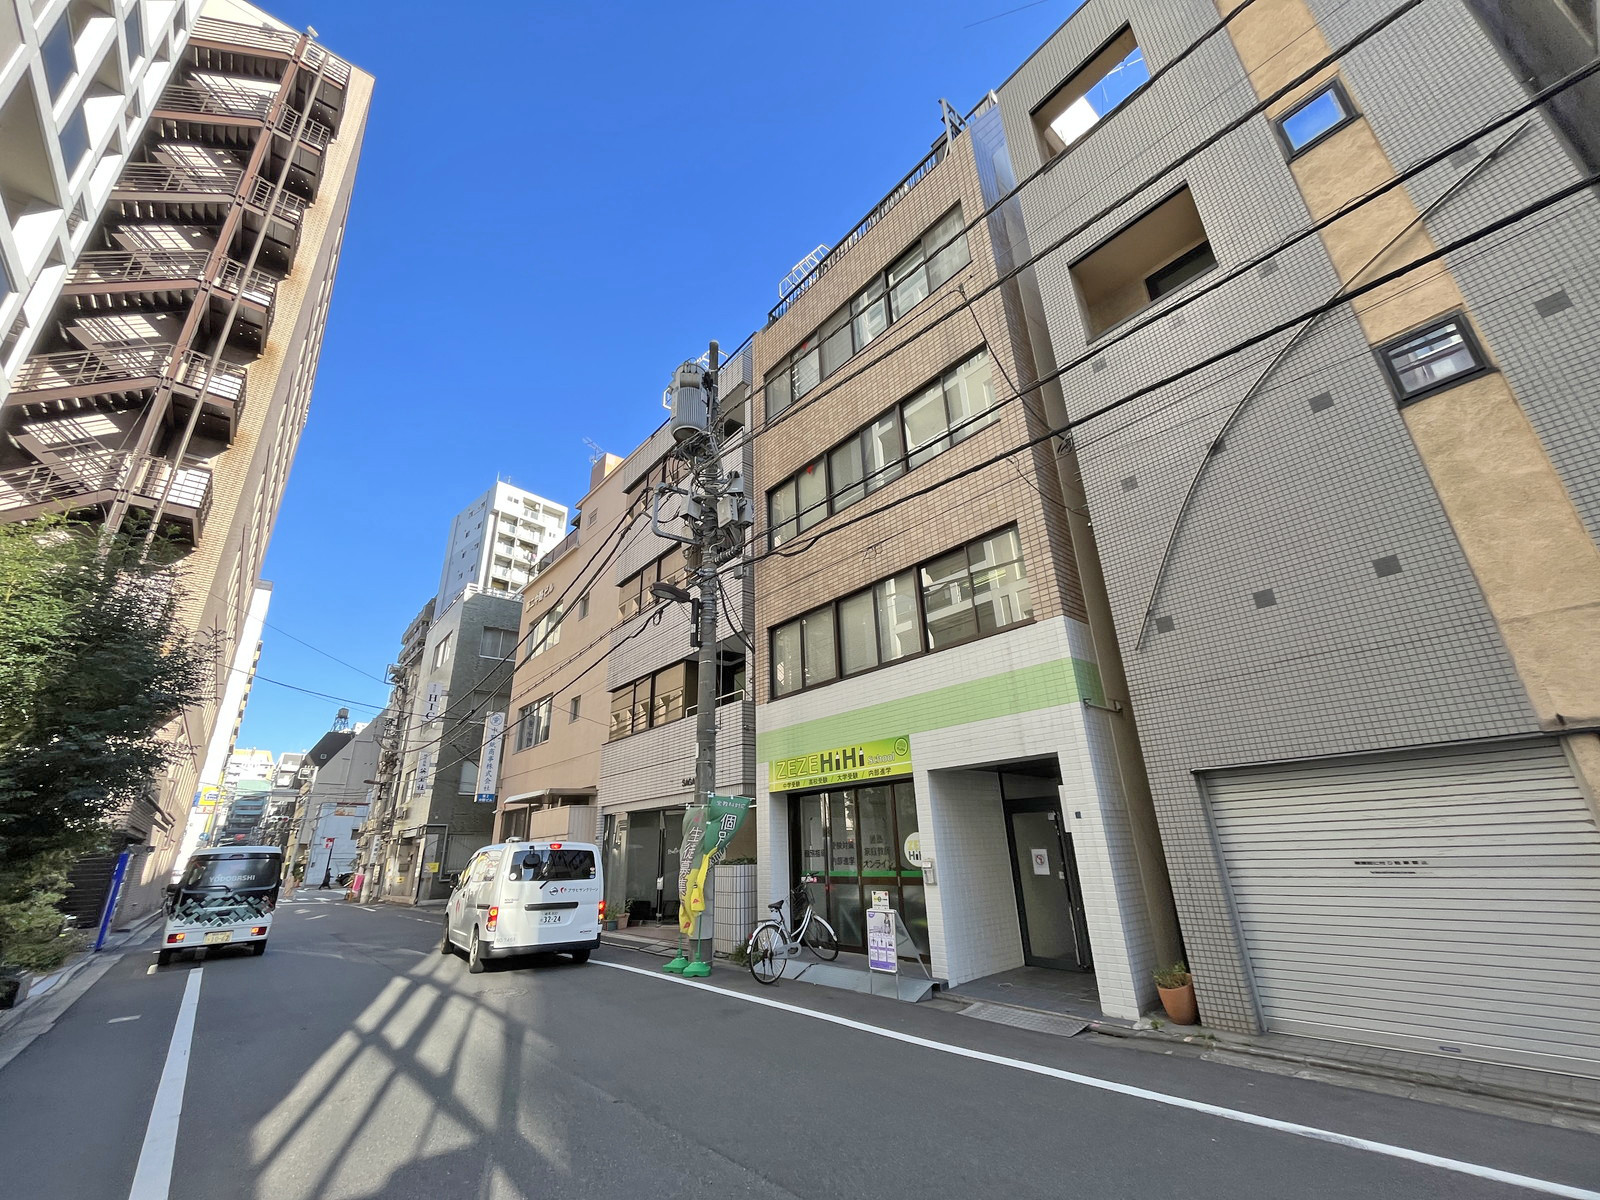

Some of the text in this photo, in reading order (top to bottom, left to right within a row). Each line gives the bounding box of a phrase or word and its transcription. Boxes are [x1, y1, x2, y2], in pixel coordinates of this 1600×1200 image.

[867, 751, 896, 765] School
[782, 767, 892, 789] 中学受験 高校受験 大学受験 内部進学
[863, 859, 896, 869] オンライン
[209, 874, 255, 883] YODOBASHI
[543, 915, 561, 923] 32-24
